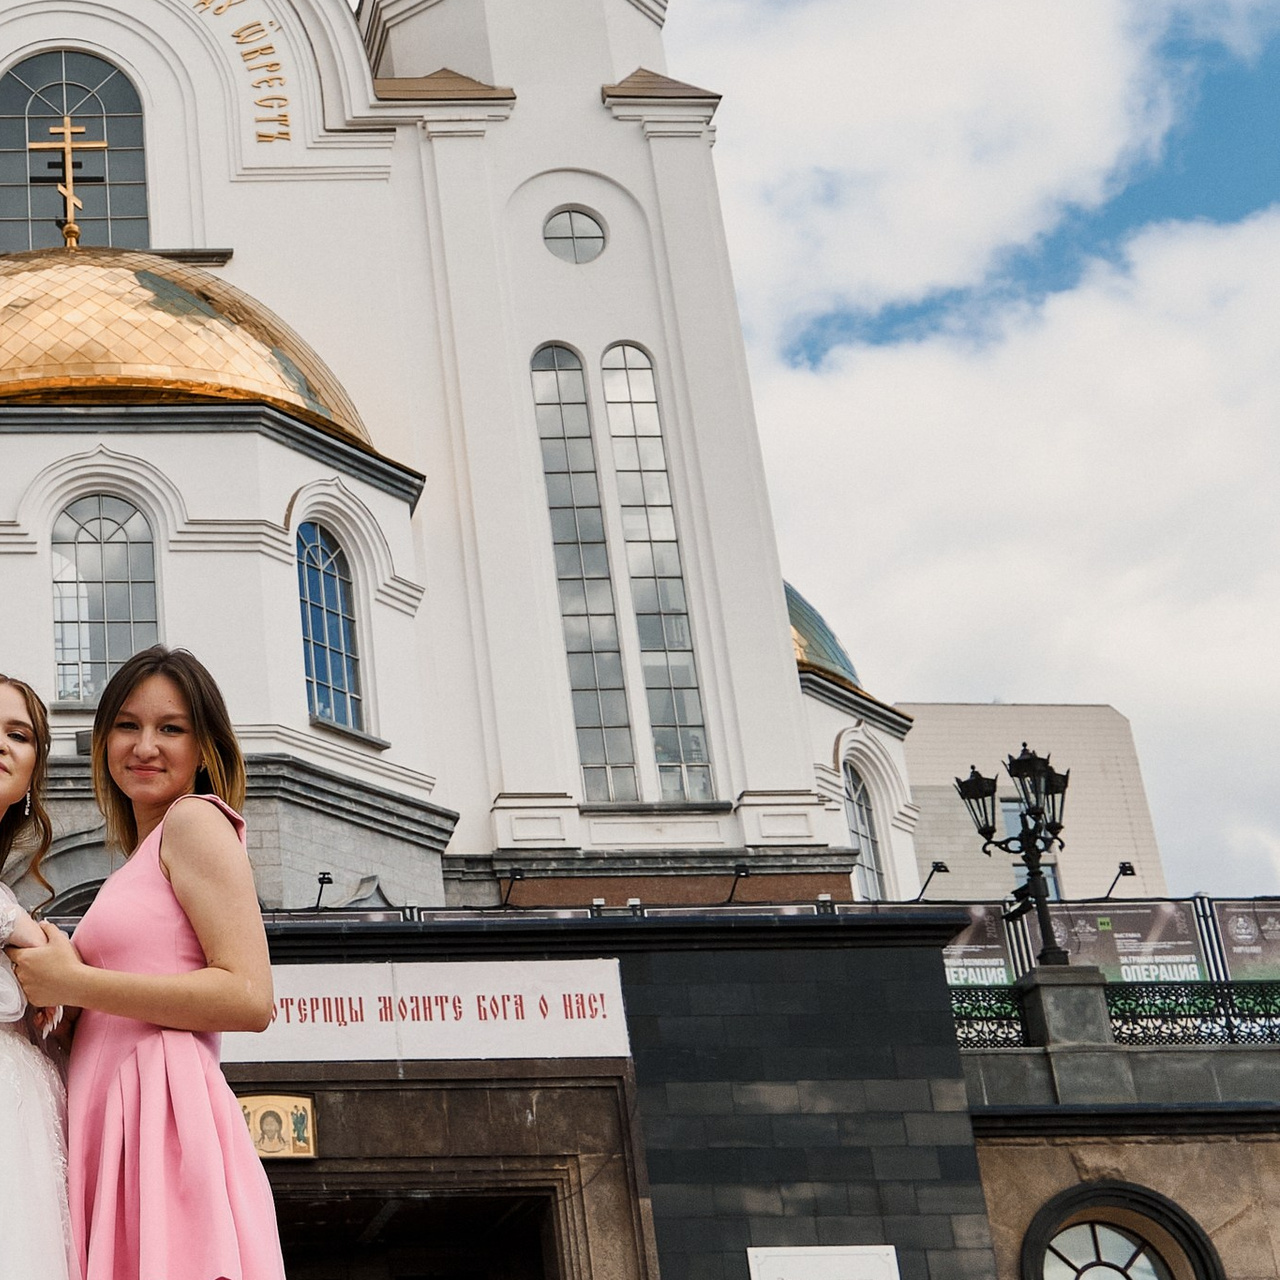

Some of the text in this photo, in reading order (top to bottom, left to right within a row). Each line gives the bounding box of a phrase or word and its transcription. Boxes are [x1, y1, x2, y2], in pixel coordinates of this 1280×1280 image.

[1121, 964, 1200, 982] ОПЕРАЦИЯ
[378, 995, 462, 1022] МОЛИТЕ
[477, 995, 525, 1021] БОГА
[538, 994, 549, 1020] О
[562, 993, 607, 1019] НАС!
